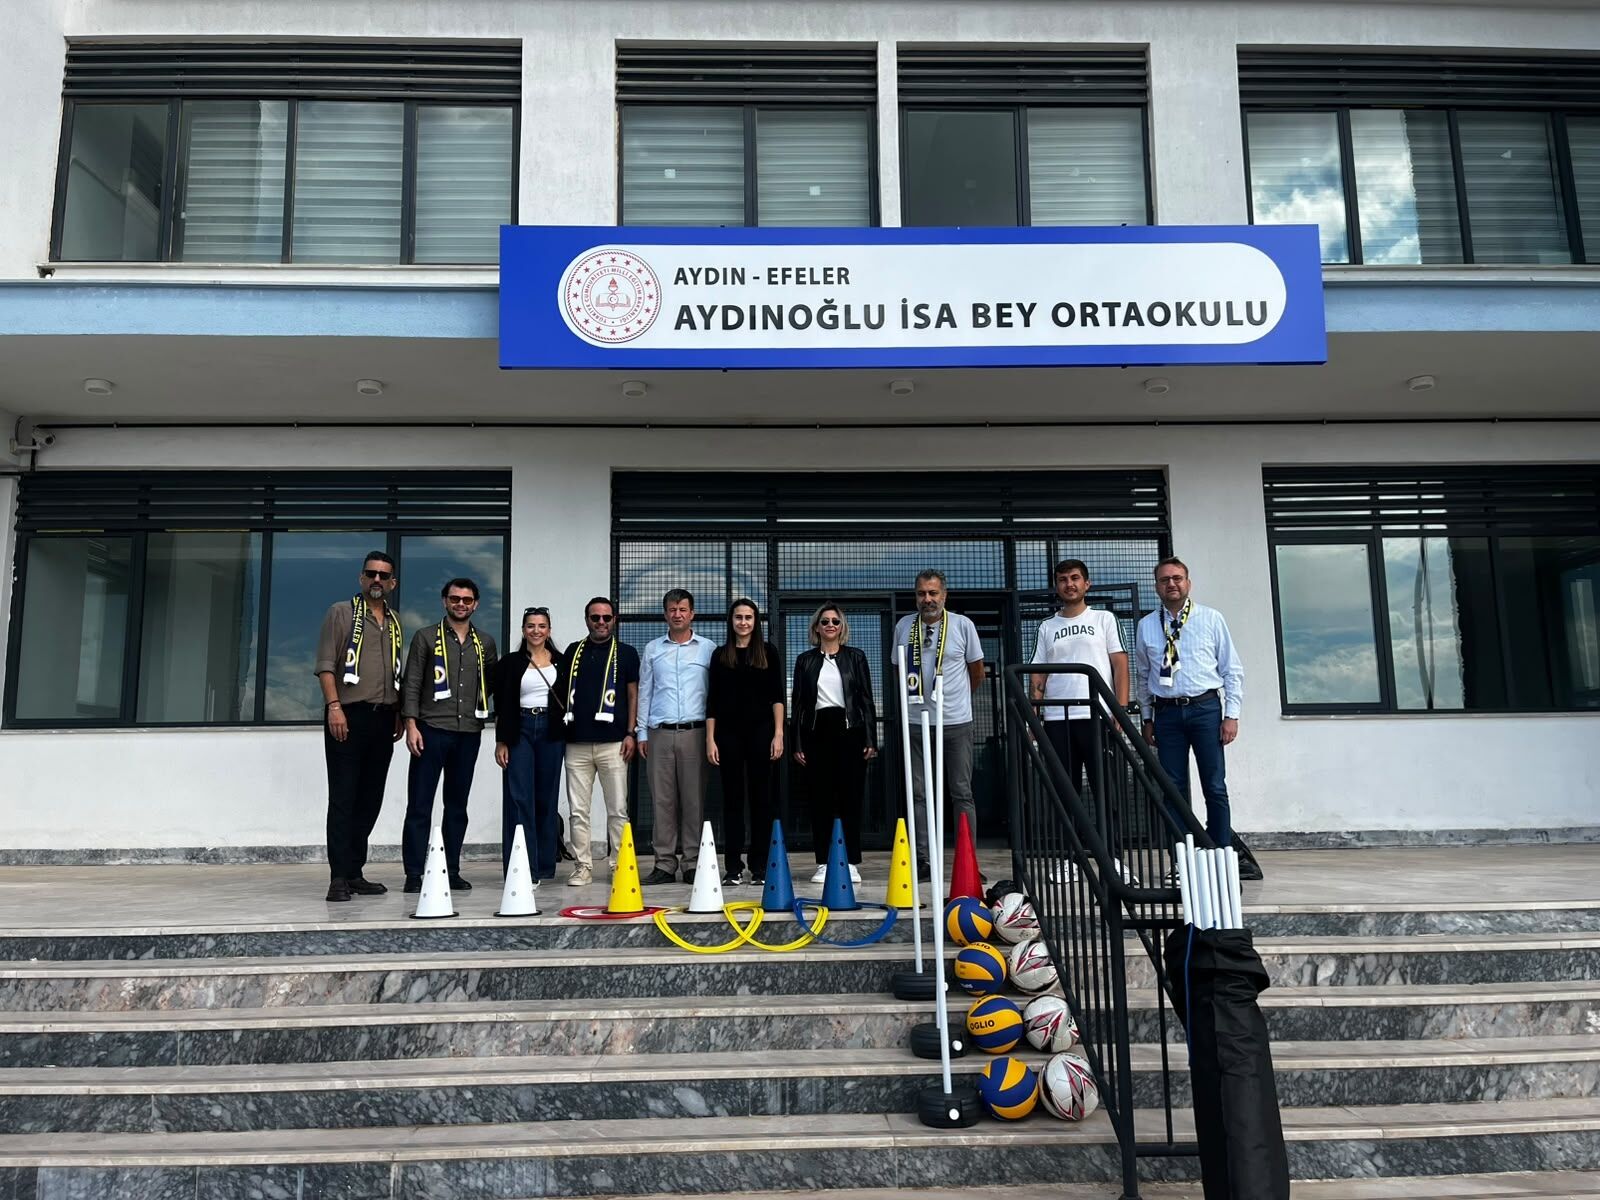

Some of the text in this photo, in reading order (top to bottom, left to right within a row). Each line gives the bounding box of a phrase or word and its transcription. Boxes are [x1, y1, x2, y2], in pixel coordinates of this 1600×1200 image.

[674, 267, 746, 286] AYDIN
[767, 267, 850, 286] EFELER
[673, 297, 1268, 331] AYDINOĞLU İSA BEY ORTAOKULU
[1054, 624, 1095, 642] ADIDAS
